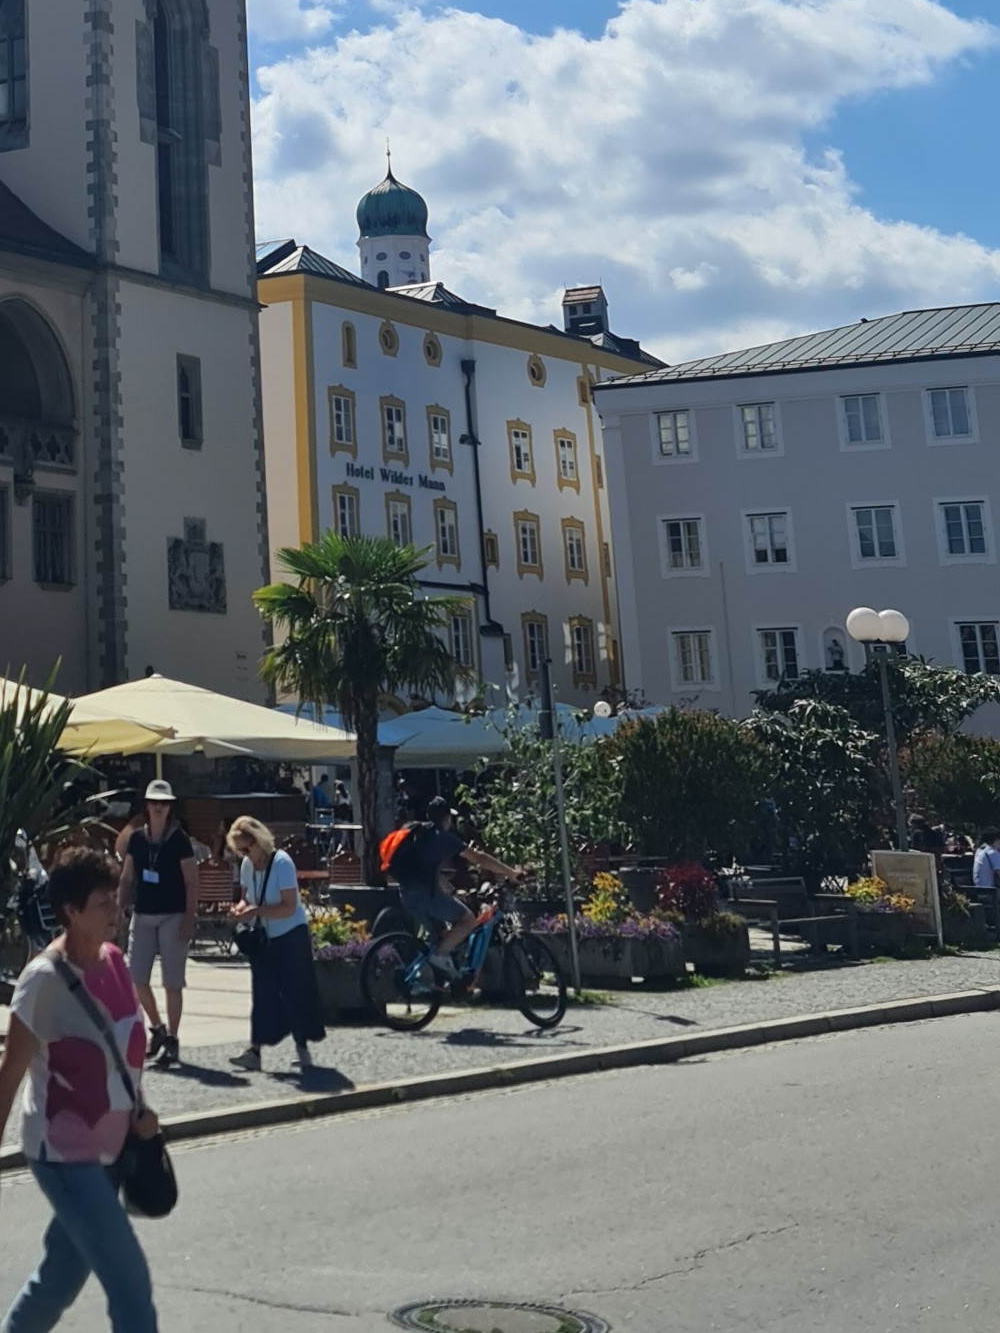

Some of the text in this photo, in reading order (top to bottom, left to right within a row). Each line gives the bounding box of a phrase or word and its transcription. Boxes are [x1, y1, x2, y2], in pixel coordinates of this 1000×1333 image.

[346, 462, 446, 492] Hotel Wilder Mann
